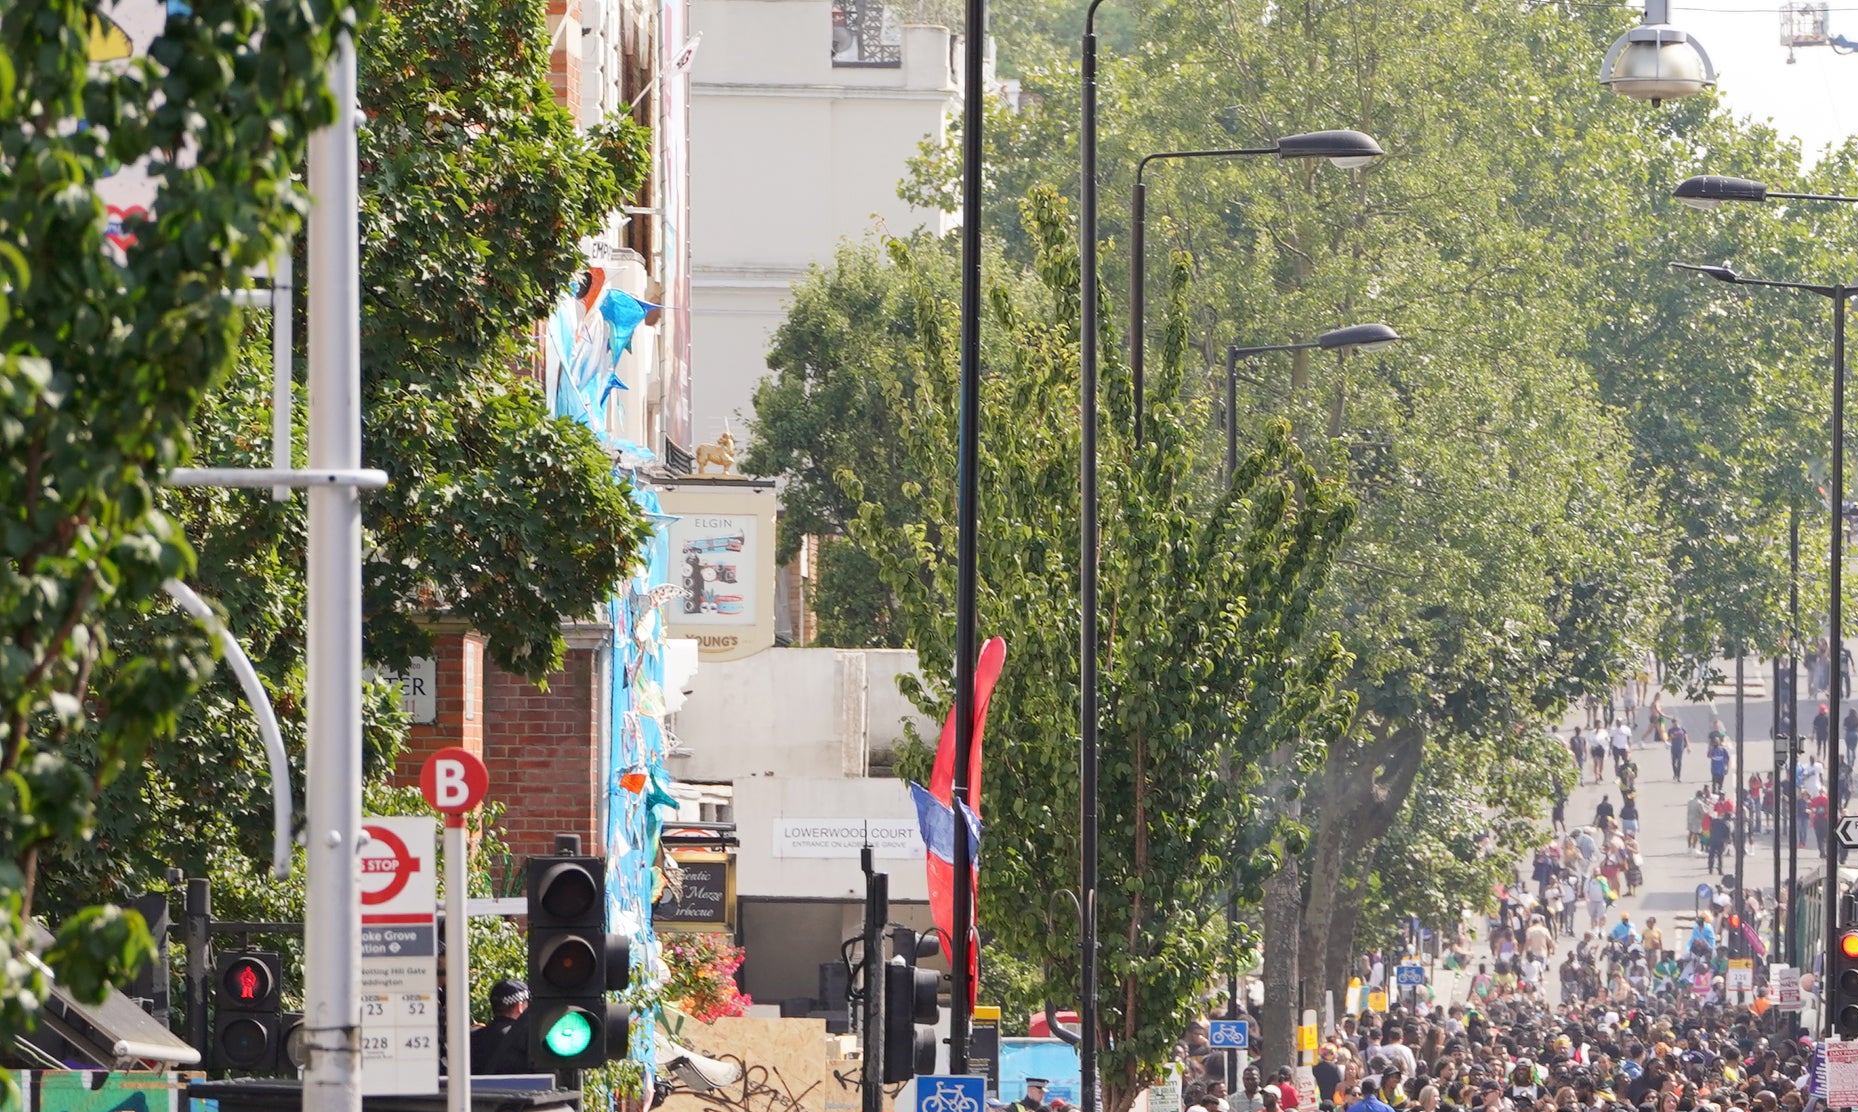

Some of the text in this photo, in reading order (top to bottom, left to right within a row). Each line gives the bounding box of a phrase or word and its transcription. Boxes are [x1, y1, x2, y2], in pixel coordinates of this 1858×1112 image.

[695, 519, 733, 528] ELGIN
[435, 759, 470, 807] B
[785, 828, 914, 839] LOWERWOOD COURT
[368, 860, 400, 871] STOP
[675, 903, 713, 917] rbecue
[384, 931, 417, 941] Grove
[361, 967, 426, 976] otting Hill Gate
[361, 979, 403, 987] addington
[367, 1003, 425, 1015] 23 52
[364, 1036, 430, 1049] 228 452
